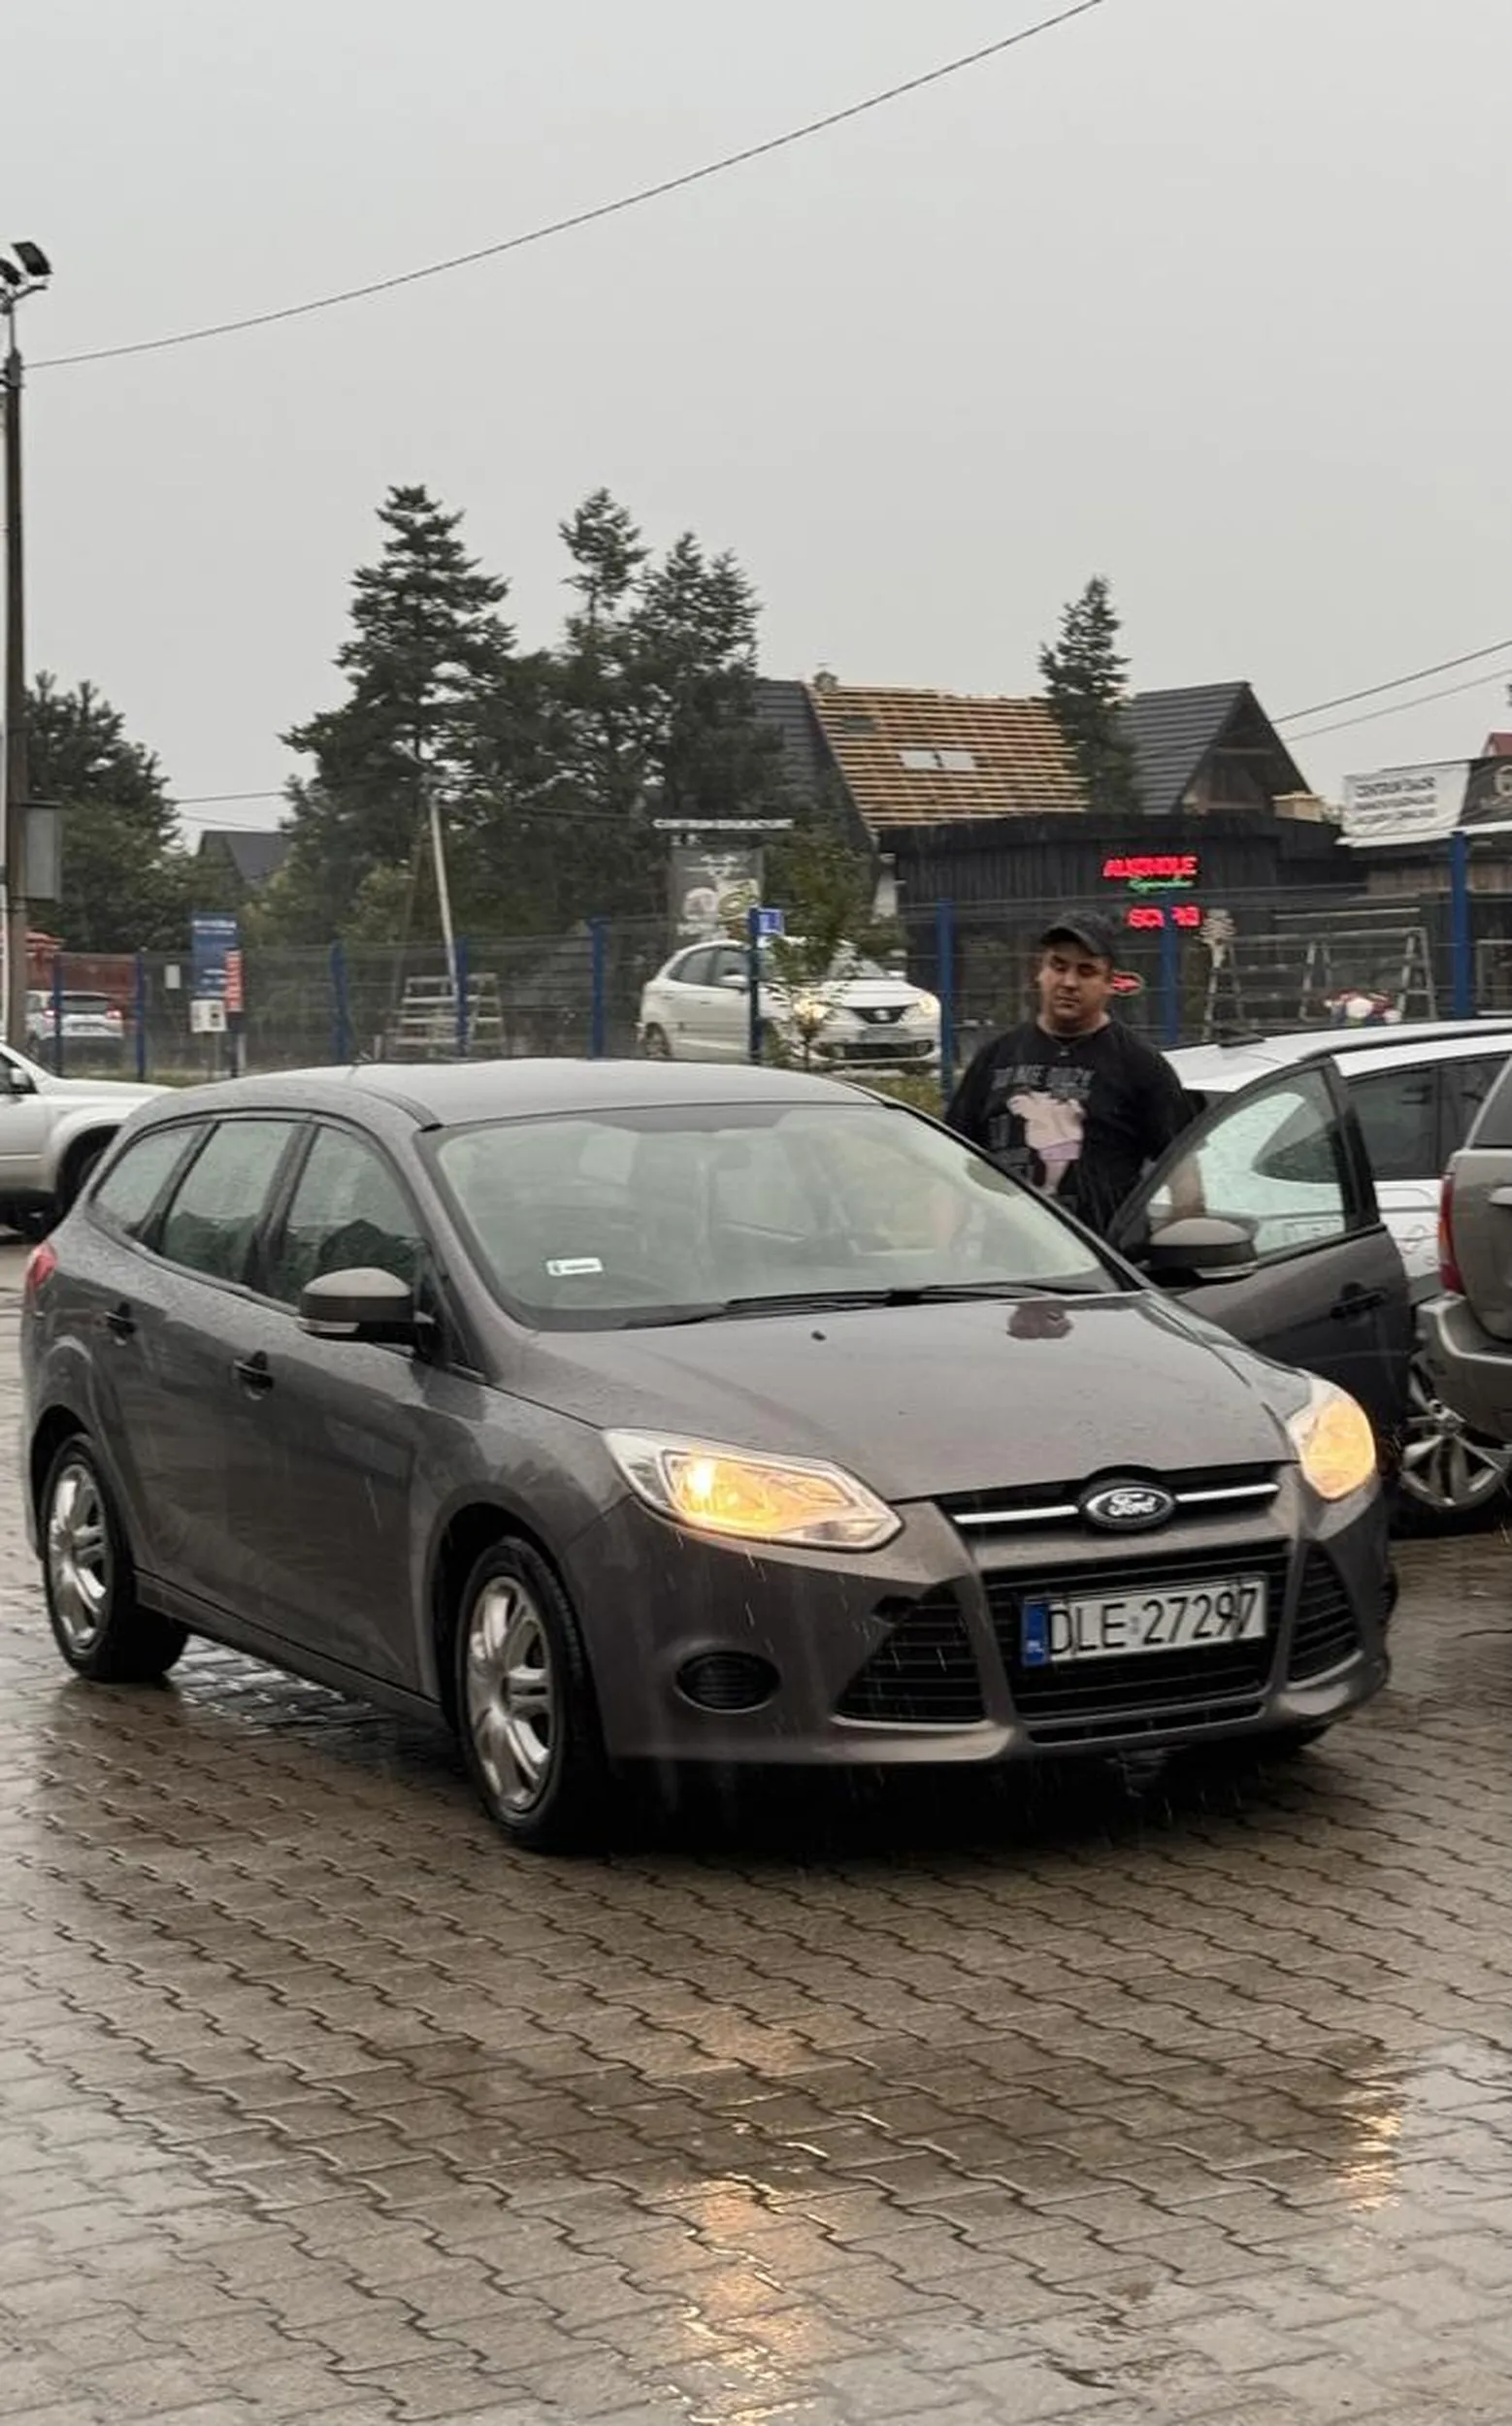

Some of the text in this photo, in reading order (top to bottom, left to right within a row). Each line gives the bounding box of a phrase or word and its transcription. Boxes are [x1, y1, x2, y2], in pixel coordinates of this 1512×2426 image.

[1108, 1492, 1156, 1516] Ford
[1049, 1588, 1258, 1655] DLE 27297
